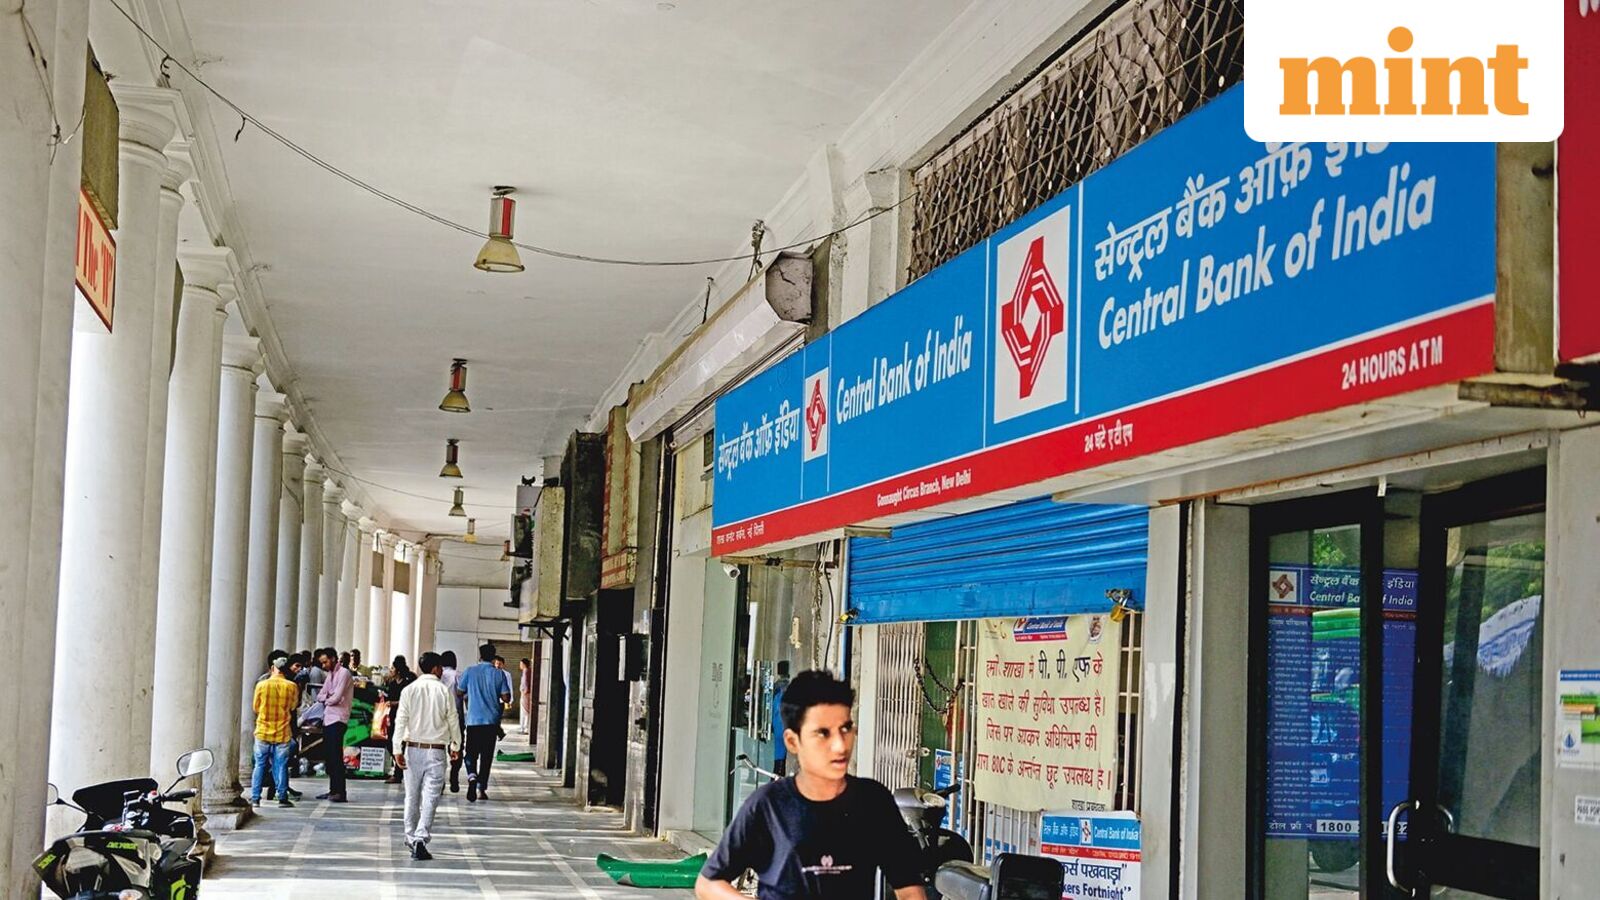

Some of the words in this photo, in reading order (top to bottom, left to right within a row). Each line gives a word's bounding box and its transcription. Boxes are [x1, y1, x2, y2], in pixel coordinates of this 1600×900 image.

[1175, 173, 1230, 239] बैंक
[1098, 259, 1190, 350] Central
[1195, 225, 1277, 313] Bank
[1284, 198, 1325, 278] of
[1331, 162, 1437, 261] India
[836, 357, 877, 425] Central
[878, 341, 913, 407] Bank
[915, 329, 932, 392] of
[933, 314, 973, 384] India
[1341, 363, 1357, 390] 24
[1359, 346, 1406, 384] HOURS
[740, 421, 755, 463] बैंक
[774, 399, 801, 455] इंडिया
[1084, 434, 1093, 453] 24
[942, 474, 955, 490] New
[956, 468, 972, 486] Delhi
[1309, 591, 1345, 603] Central
[1347, 593, 1360, 603] Ba
[1389, 594, 1413, 606] India
[1002, 661, 1025, 679] शाखा
[1092, 651, 1103, 677] के
[1018, 689, 1030, 712] की
[1084, 724, 1097, 751] की
[1320, 822, 1352, 832] 1800
